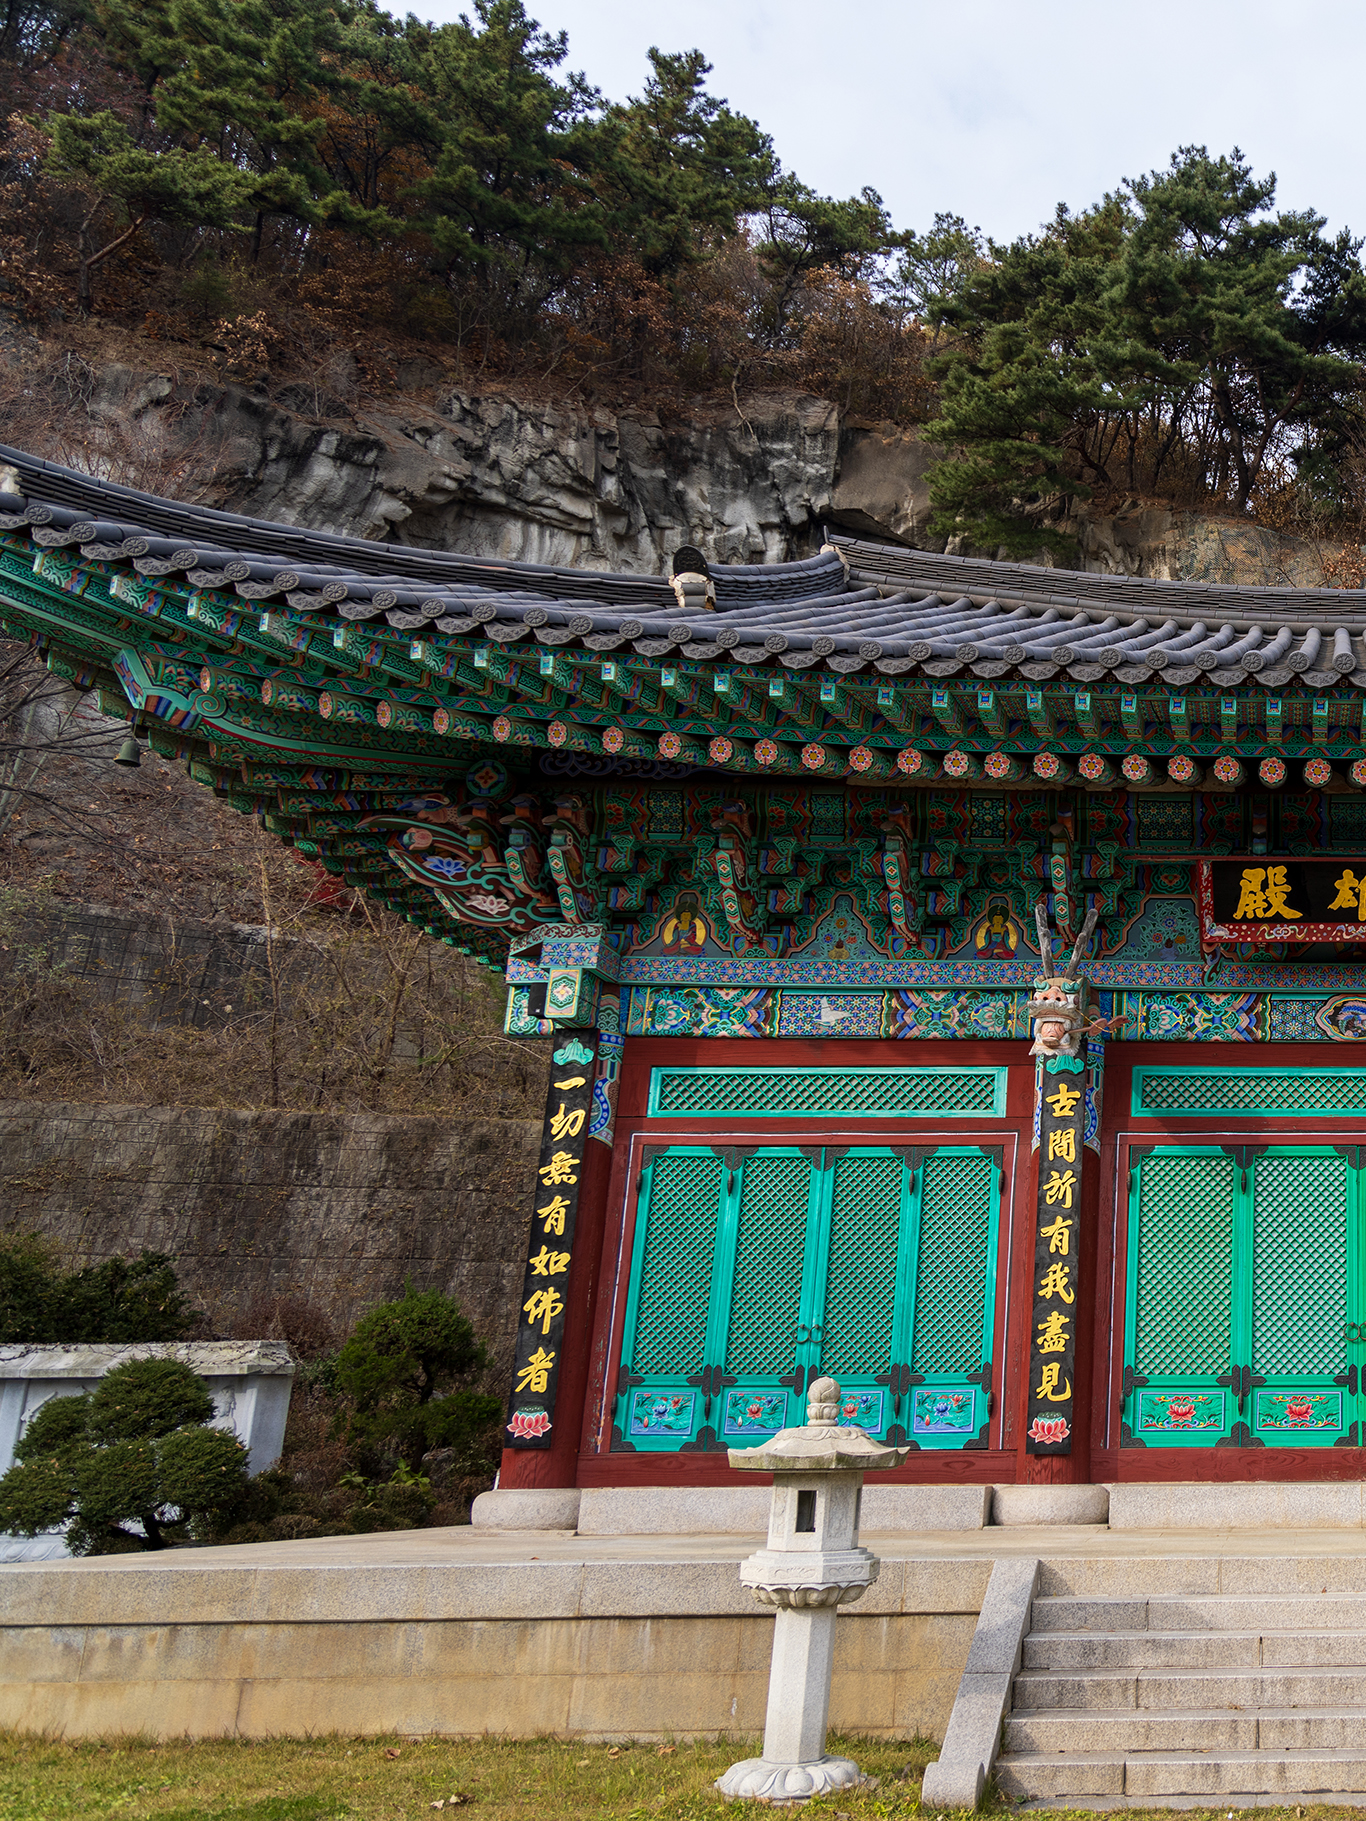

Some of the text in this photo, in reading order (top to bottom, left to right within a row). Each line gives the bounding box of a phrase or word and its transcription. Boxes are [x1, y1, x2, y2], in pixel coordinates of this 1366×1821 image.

[515, 1076, 586, 1394] 一切無有如佛者
